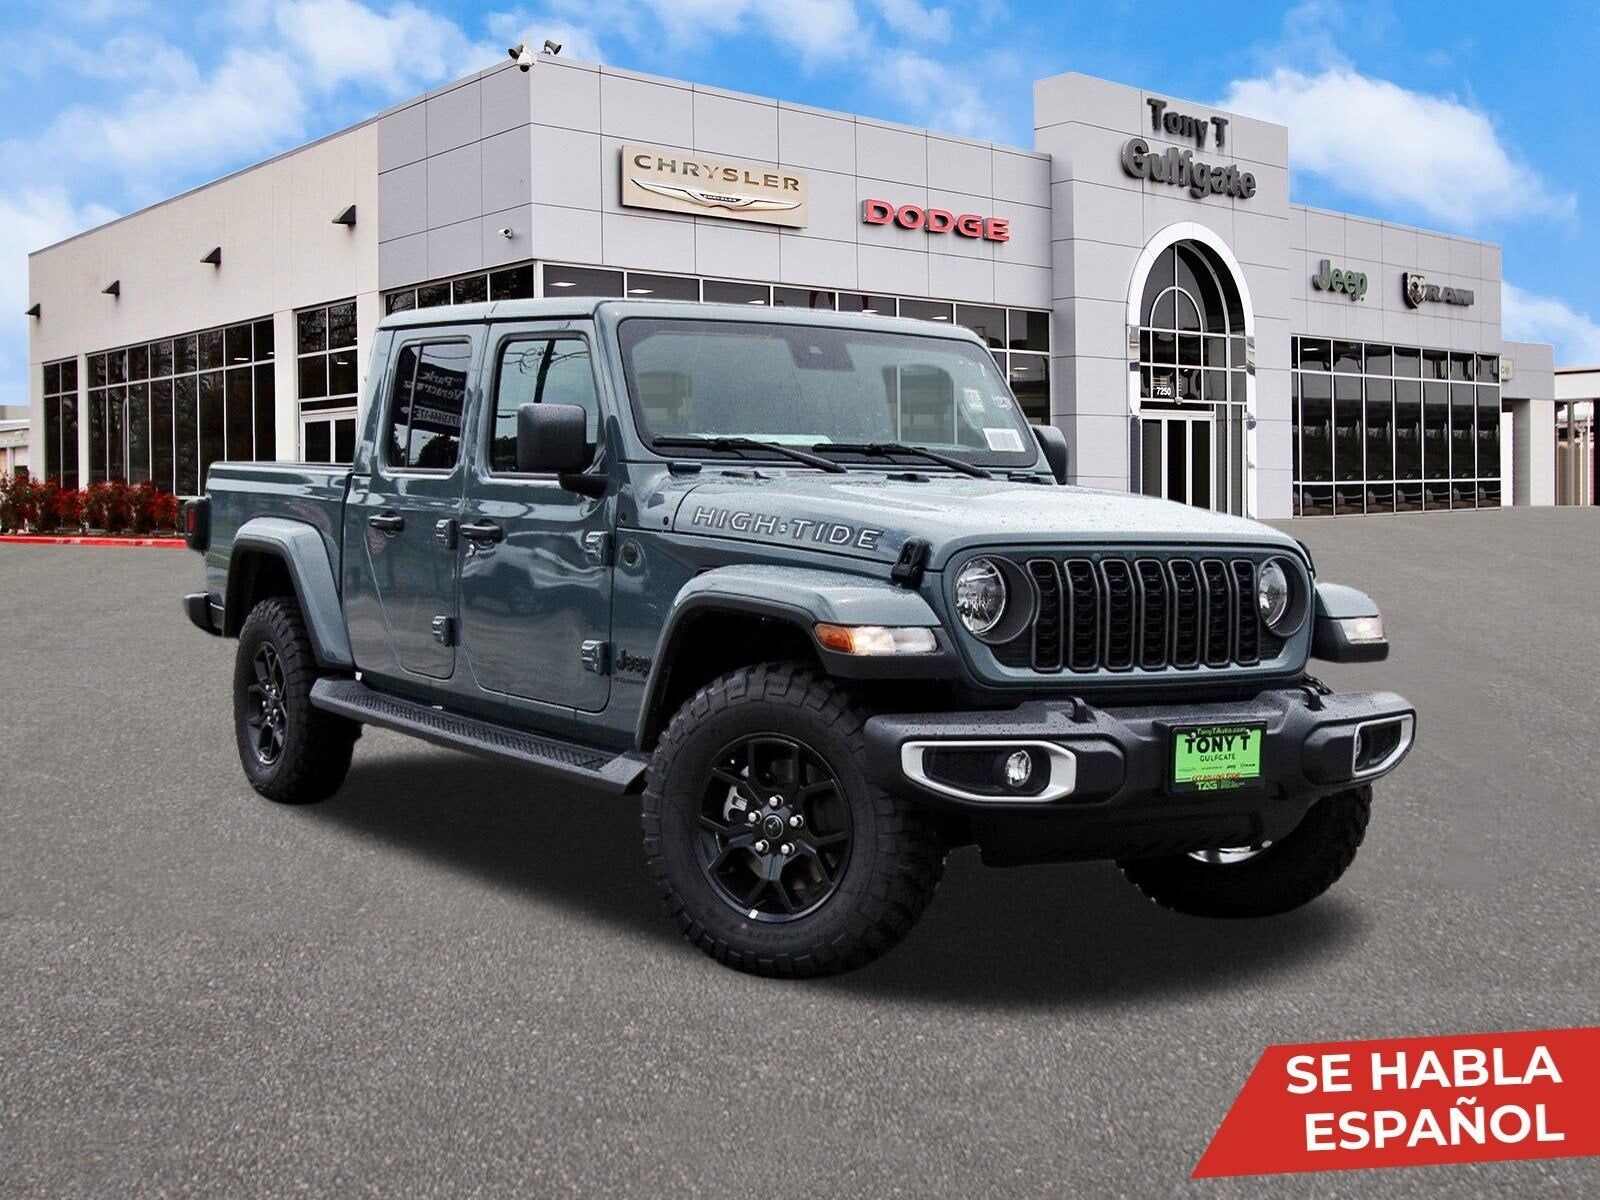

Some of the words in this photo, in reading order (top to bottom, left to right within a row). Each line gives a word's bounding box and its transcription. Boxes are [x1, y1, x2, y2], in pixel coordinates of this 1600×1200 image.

[1146, 97, 1208, 148] Tony
[1210, 116, 1229, 147] T
[633, 154, 801, 192] CHRYSLER
[1121, 137, 1256, 199] Gulfgate
[862, 198, 1010, 242] DODGE
[1312, 259, 1368, 301] Jeep
[1424, 283, 1475, 306] RAM
[1156, 387, 1172, 396] 7250
[693, 507, 778, 534] HIGH
[791, 517, 882, 550] TIDE
[616, 650, 652, 678] Jeep
[1185, 736, 1235, 754] TONY
[1241, 734, 1250, 750] T
[1200, 754, 1235, 762] GULFGATE
